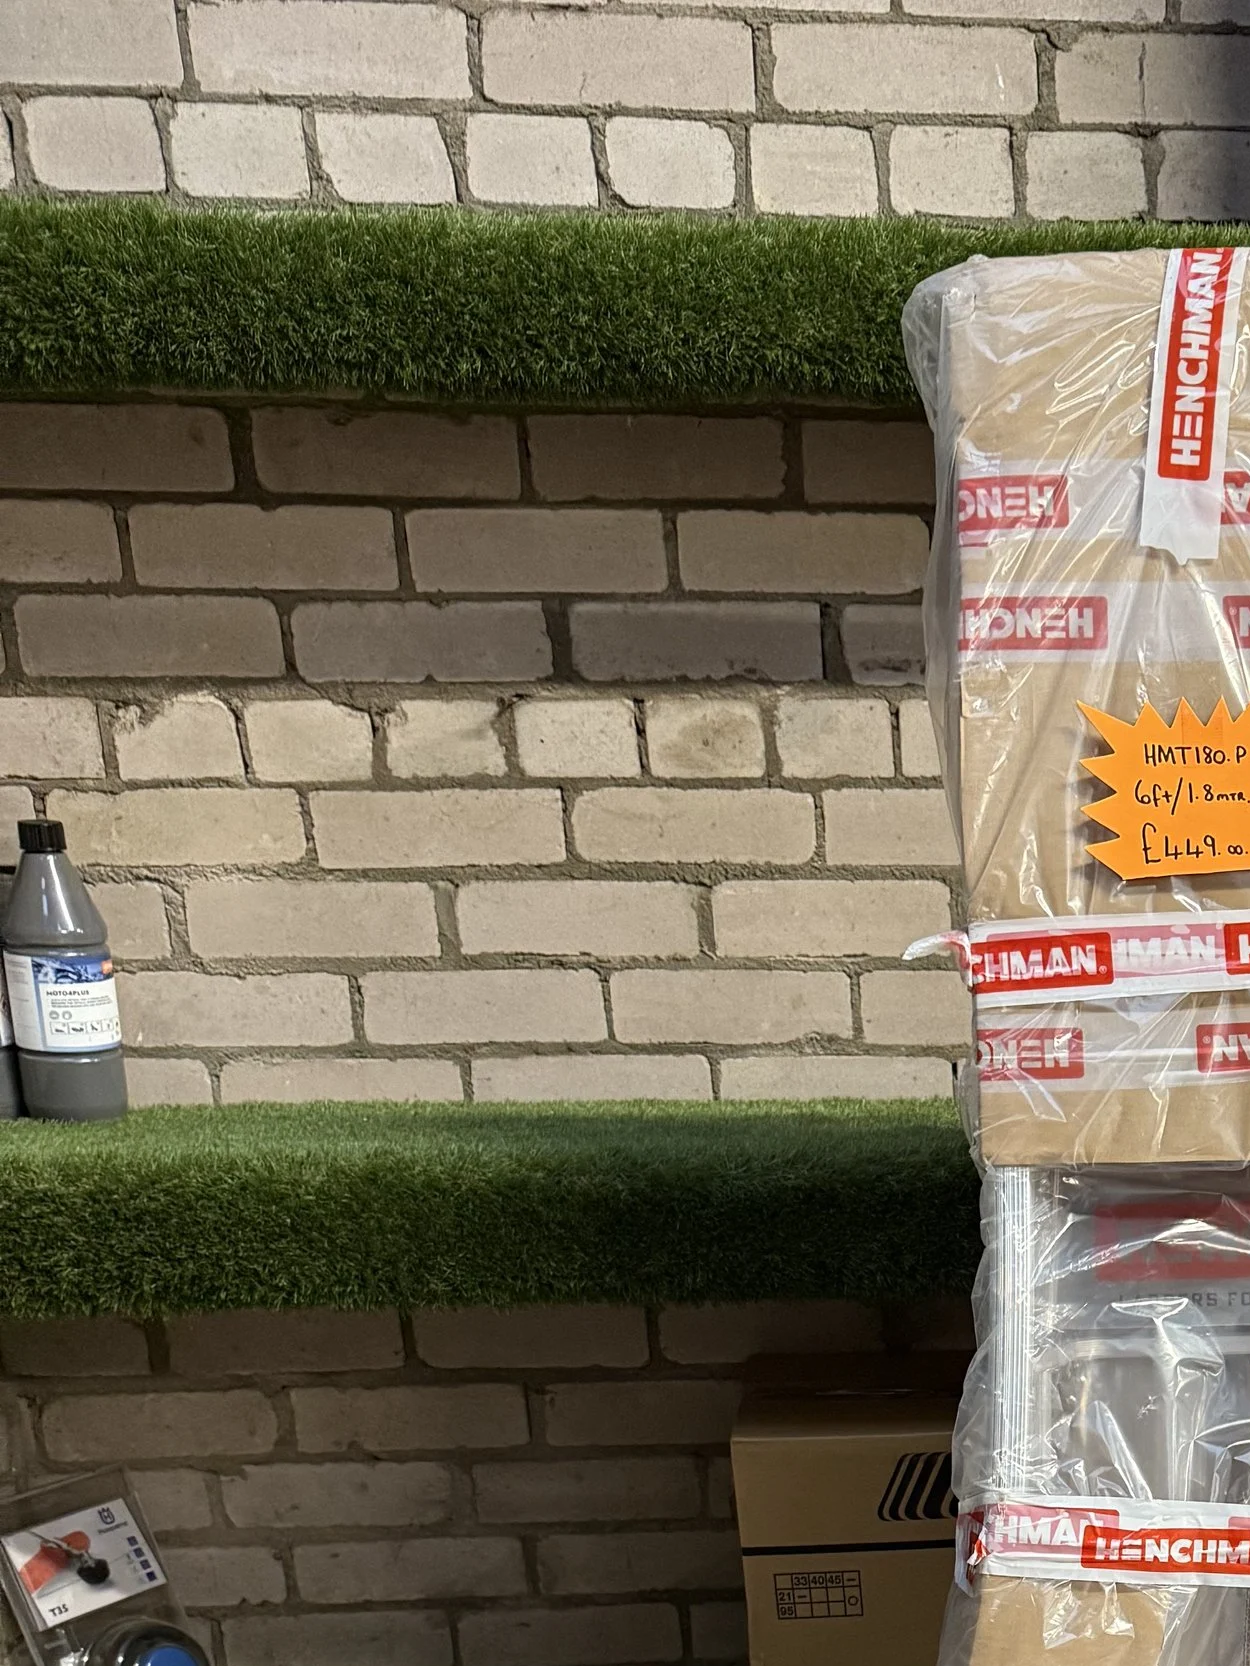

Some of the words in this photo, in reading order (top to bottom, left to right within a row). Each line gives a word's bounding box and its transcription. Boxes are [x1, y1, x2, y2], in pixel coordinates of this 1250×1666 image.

[1170, 251, 1222, 466] HENCHMAN
[794, 1576, 807, 1586] 33
[811, 1575, 824, 1585] 40
[828, 1575, 841, 1585] 45
[778, 1592, 792, 1601] 21
[48, 1603, 69, 1617] T35
[780, 1606, 793, 1616] 95
